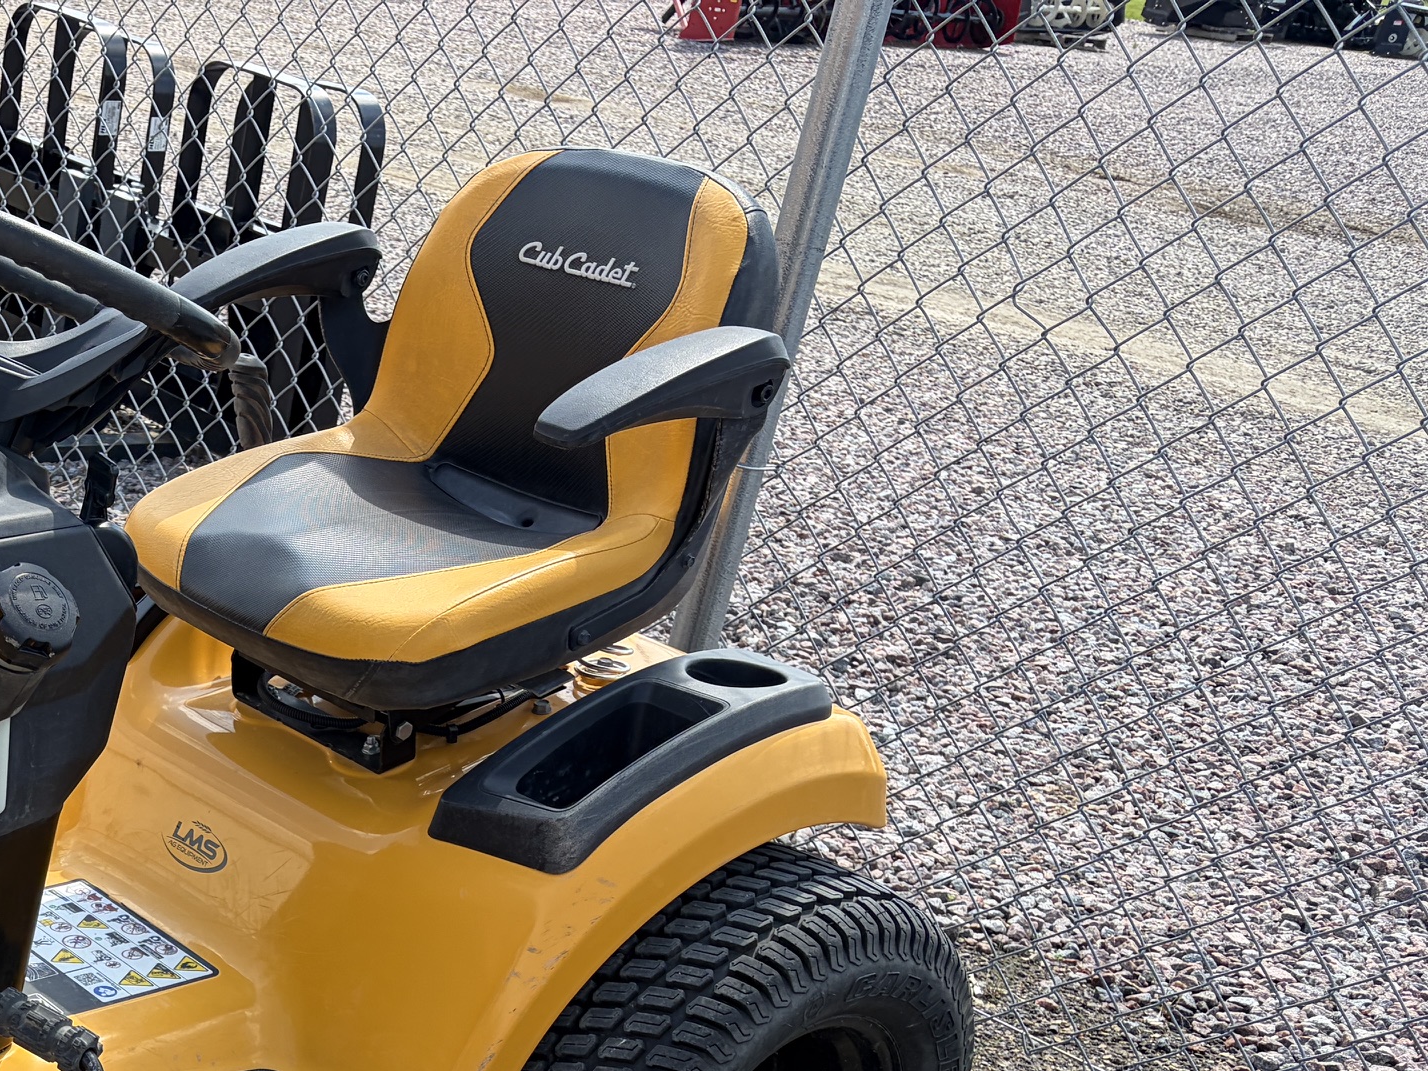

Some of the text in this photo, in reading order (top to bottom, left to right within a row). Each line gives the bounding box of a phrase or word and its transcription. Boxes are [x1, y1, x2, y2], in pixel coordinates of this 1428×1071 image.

[518, 241, 640, 288] Cub Cadet
[172, 820, 220, 861] LMS
[176, 845, 209, 867] EQUIPMENT
